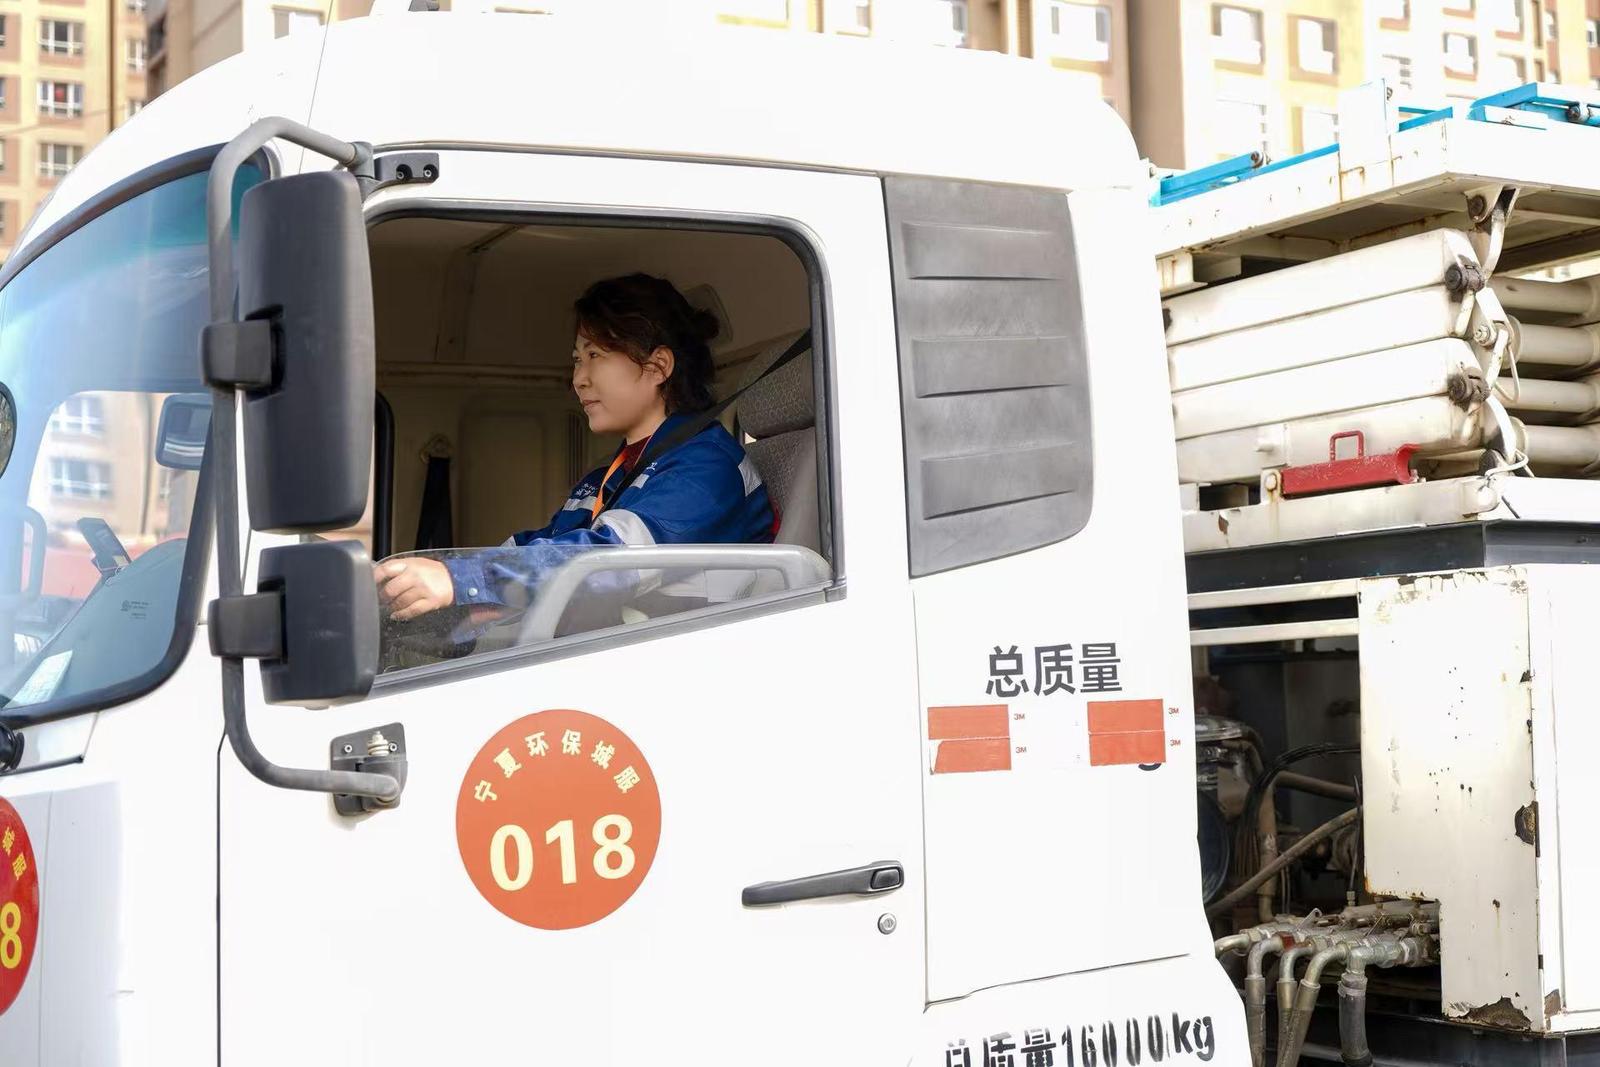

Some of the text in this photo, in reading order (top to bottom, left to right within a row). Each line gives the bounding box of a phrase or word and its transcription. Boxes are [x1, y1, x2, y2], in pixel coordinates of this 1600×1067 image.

[985, 642, 1122, 698] 总质量
[1168, 707, 1179, 715] 3M
[1013, 713, 1026, 721] 3M
[1170, 739, 1181, 747] 3M
[1015, 746, 1027, 754] 3M
[474, 729, 641, 803] 宁夏环保城服
[489, 813, 636, 892] 018
